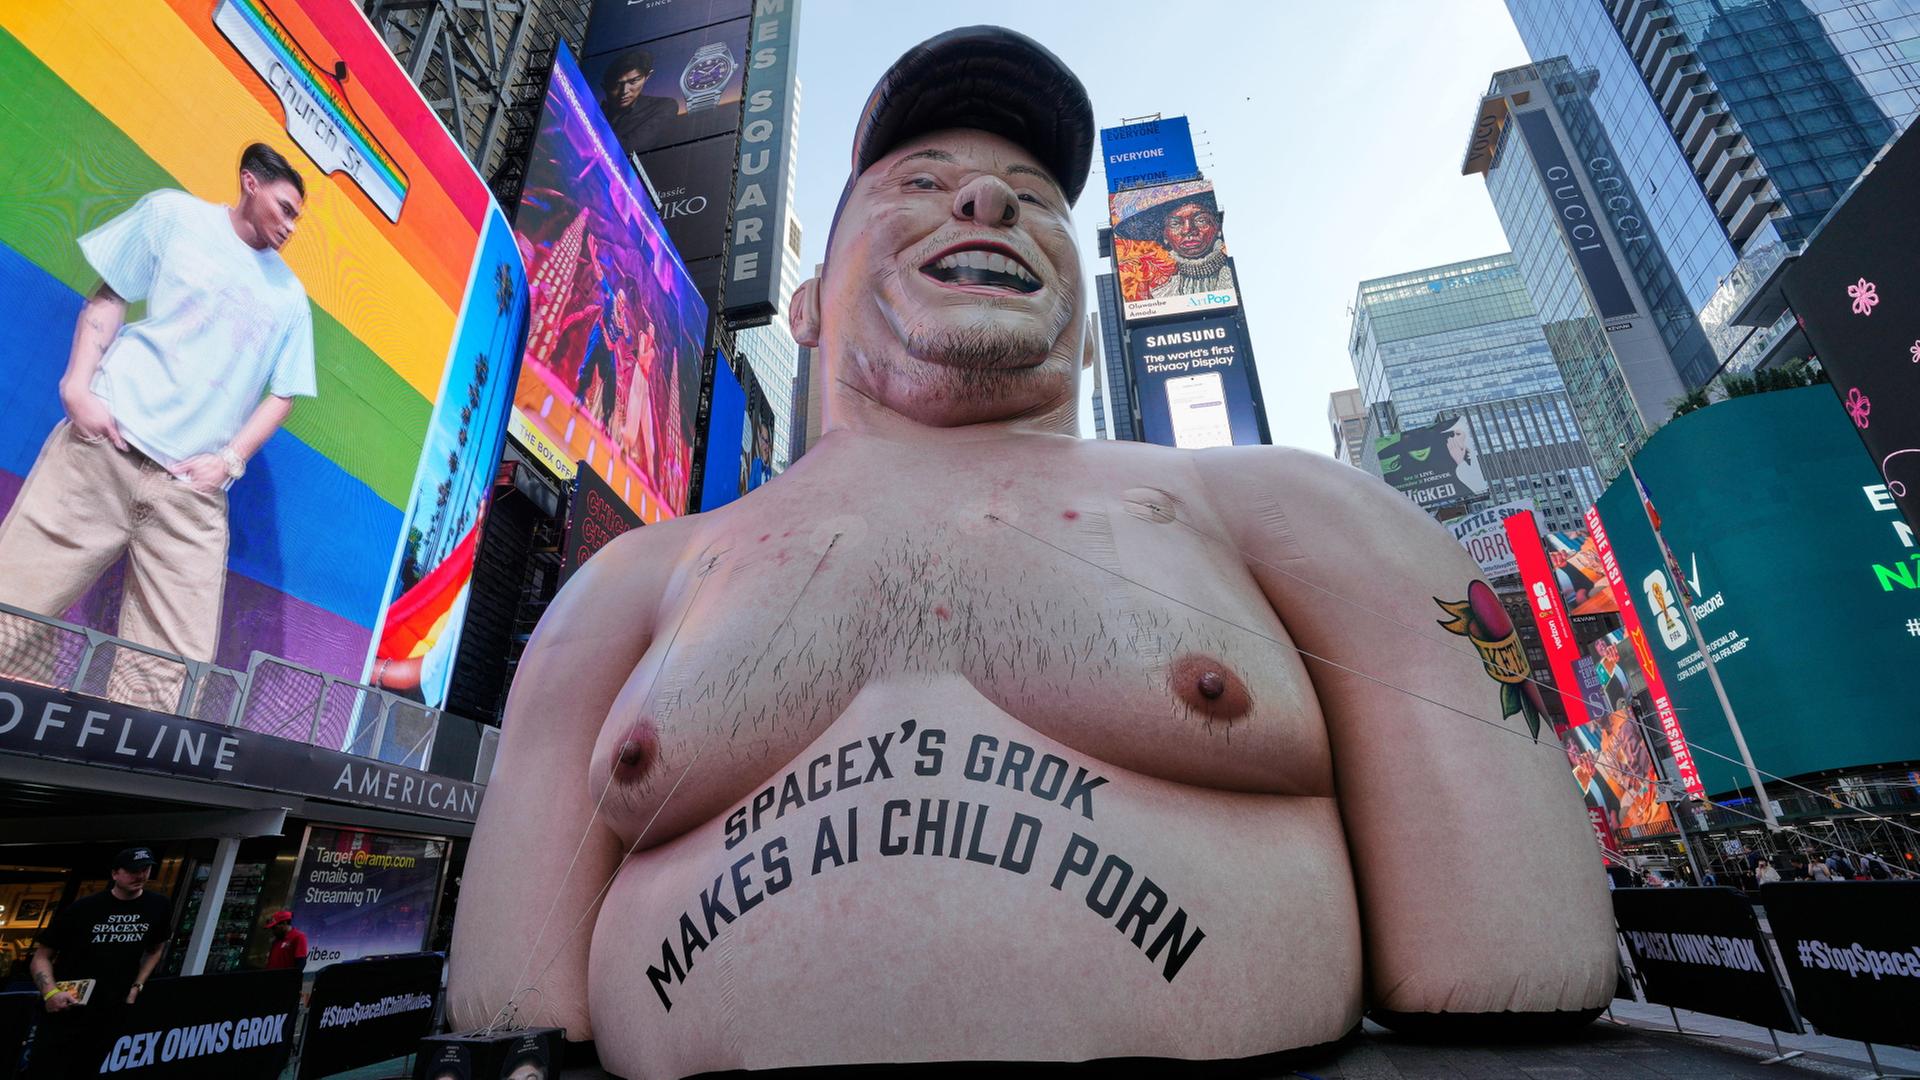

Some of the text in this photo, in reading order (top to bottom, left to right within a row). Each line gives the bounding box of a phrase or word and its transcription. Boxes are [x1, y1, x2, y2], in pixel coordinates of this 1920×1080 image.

[268, 61, 338, 152] Church
[1110, 147, 1165, 164] EVERYONE
[656, 186, 686, 199] lassic
[733, 90, 773, 281] SQUARE
[663, 195, 707, 220] IKO
[1546, 165, 1601, 251] GUCCI
[1146, 327, 1226, 347] SAMSUNG
[1143, 345, 1235, 364] The world's first
[1147, 356, 1234, 373] Privacy Display
[520, 424, 536, 446] THE
[537, 439, 555, 464] BOX
[1454, 510, 1498, 540] LITTLE
[1586, 507, 1608, 552] COME
[1690, 591, 1725, 622] Rexona
[1548, 620, 1563, 650] verizon
[1728, 629, 1739, 641] DA
[0, 692, 478, 816] OFFLINE AMERICAN
[1656, 696, 1696, 788] HERSHEY'S
[724, 718, 1109, 850] SPACEX'S GROK
[316, 846, 416, 871] Target @ramp.com
[310, 867, 364, 884] emails on
[304, 887, 382, 908] Streaming TV
[645, 798, 1207, 1013] MAKES AI CHILD PORN
[91, 923, 150, 934] SPACEX'S
[107, 914, 141, 923] STOP
[91, 933, 145, 943] AI PORN
[1626, 930, 1766, 973] PACEX OWNS GROK
[99, 1012, 289, 1074] CEX OWNS GROK
